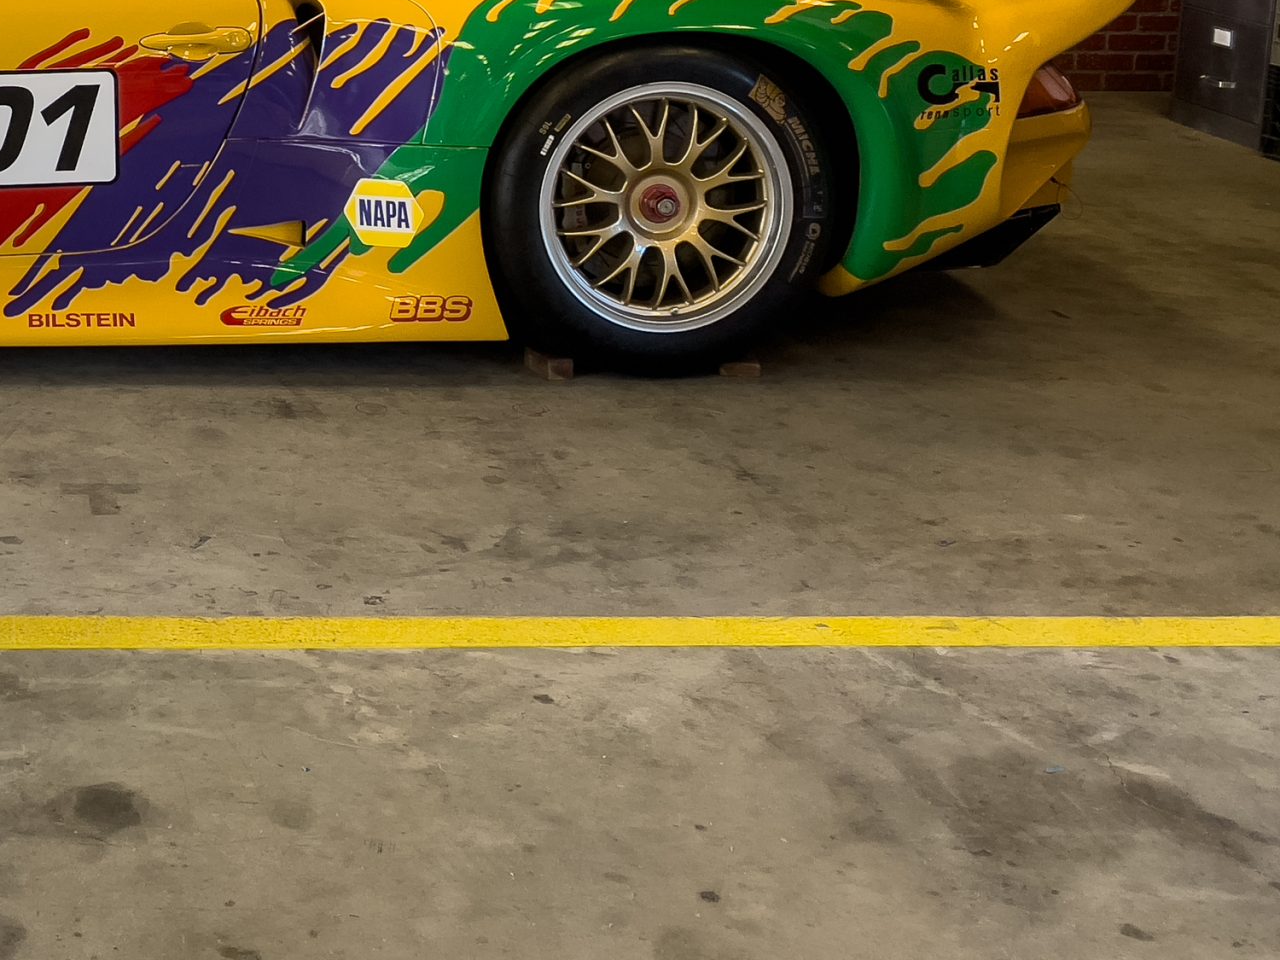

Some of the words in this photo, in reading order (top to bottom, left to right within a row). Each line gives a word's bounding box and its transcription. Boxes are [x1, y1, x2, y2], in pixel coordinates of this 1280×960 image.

[359, 199, 410, 229] NAPA
[220, 305, 307, 322] Eibach
[391, 296, 472, 322] BBS
[28, 313, 136, 328] BILSTEIN
